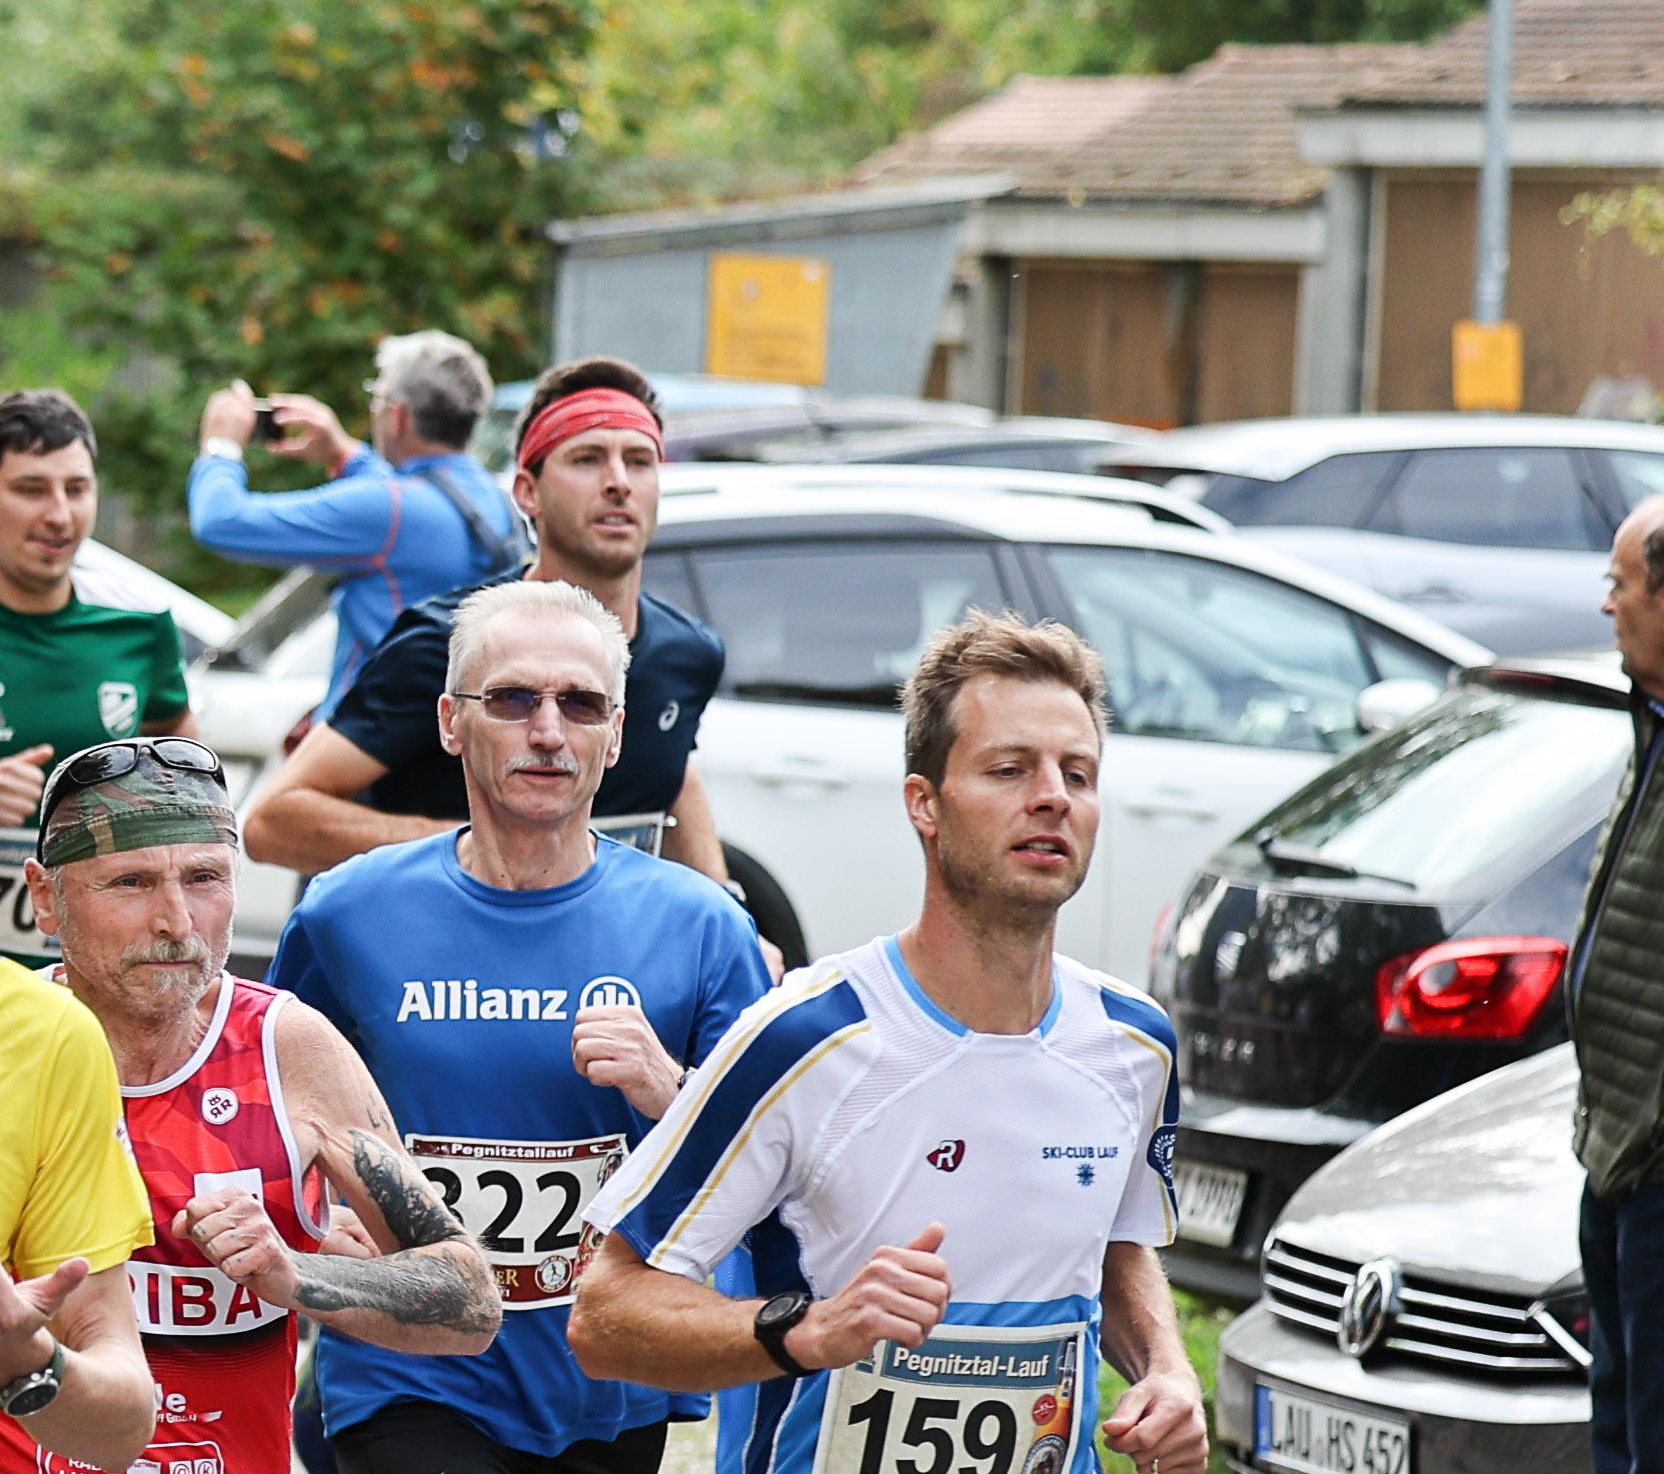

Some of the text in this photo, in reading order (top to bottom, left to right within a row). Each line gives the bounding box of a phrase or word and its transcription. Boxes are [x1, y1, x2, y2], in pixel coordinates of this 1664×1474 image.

[396, 979, 568, 1023] Allianz
[450, 1143, 575, 1159] Pegnitztallauf
[1042, 1146, 1095, 1160] SKI-CLUB
[892, 1346, 1050, 1378] Pegnitztal-Lauf
[1270, 1399, 1311, 1460] LAU
[1326, 1416, 1356, 1472] HS
